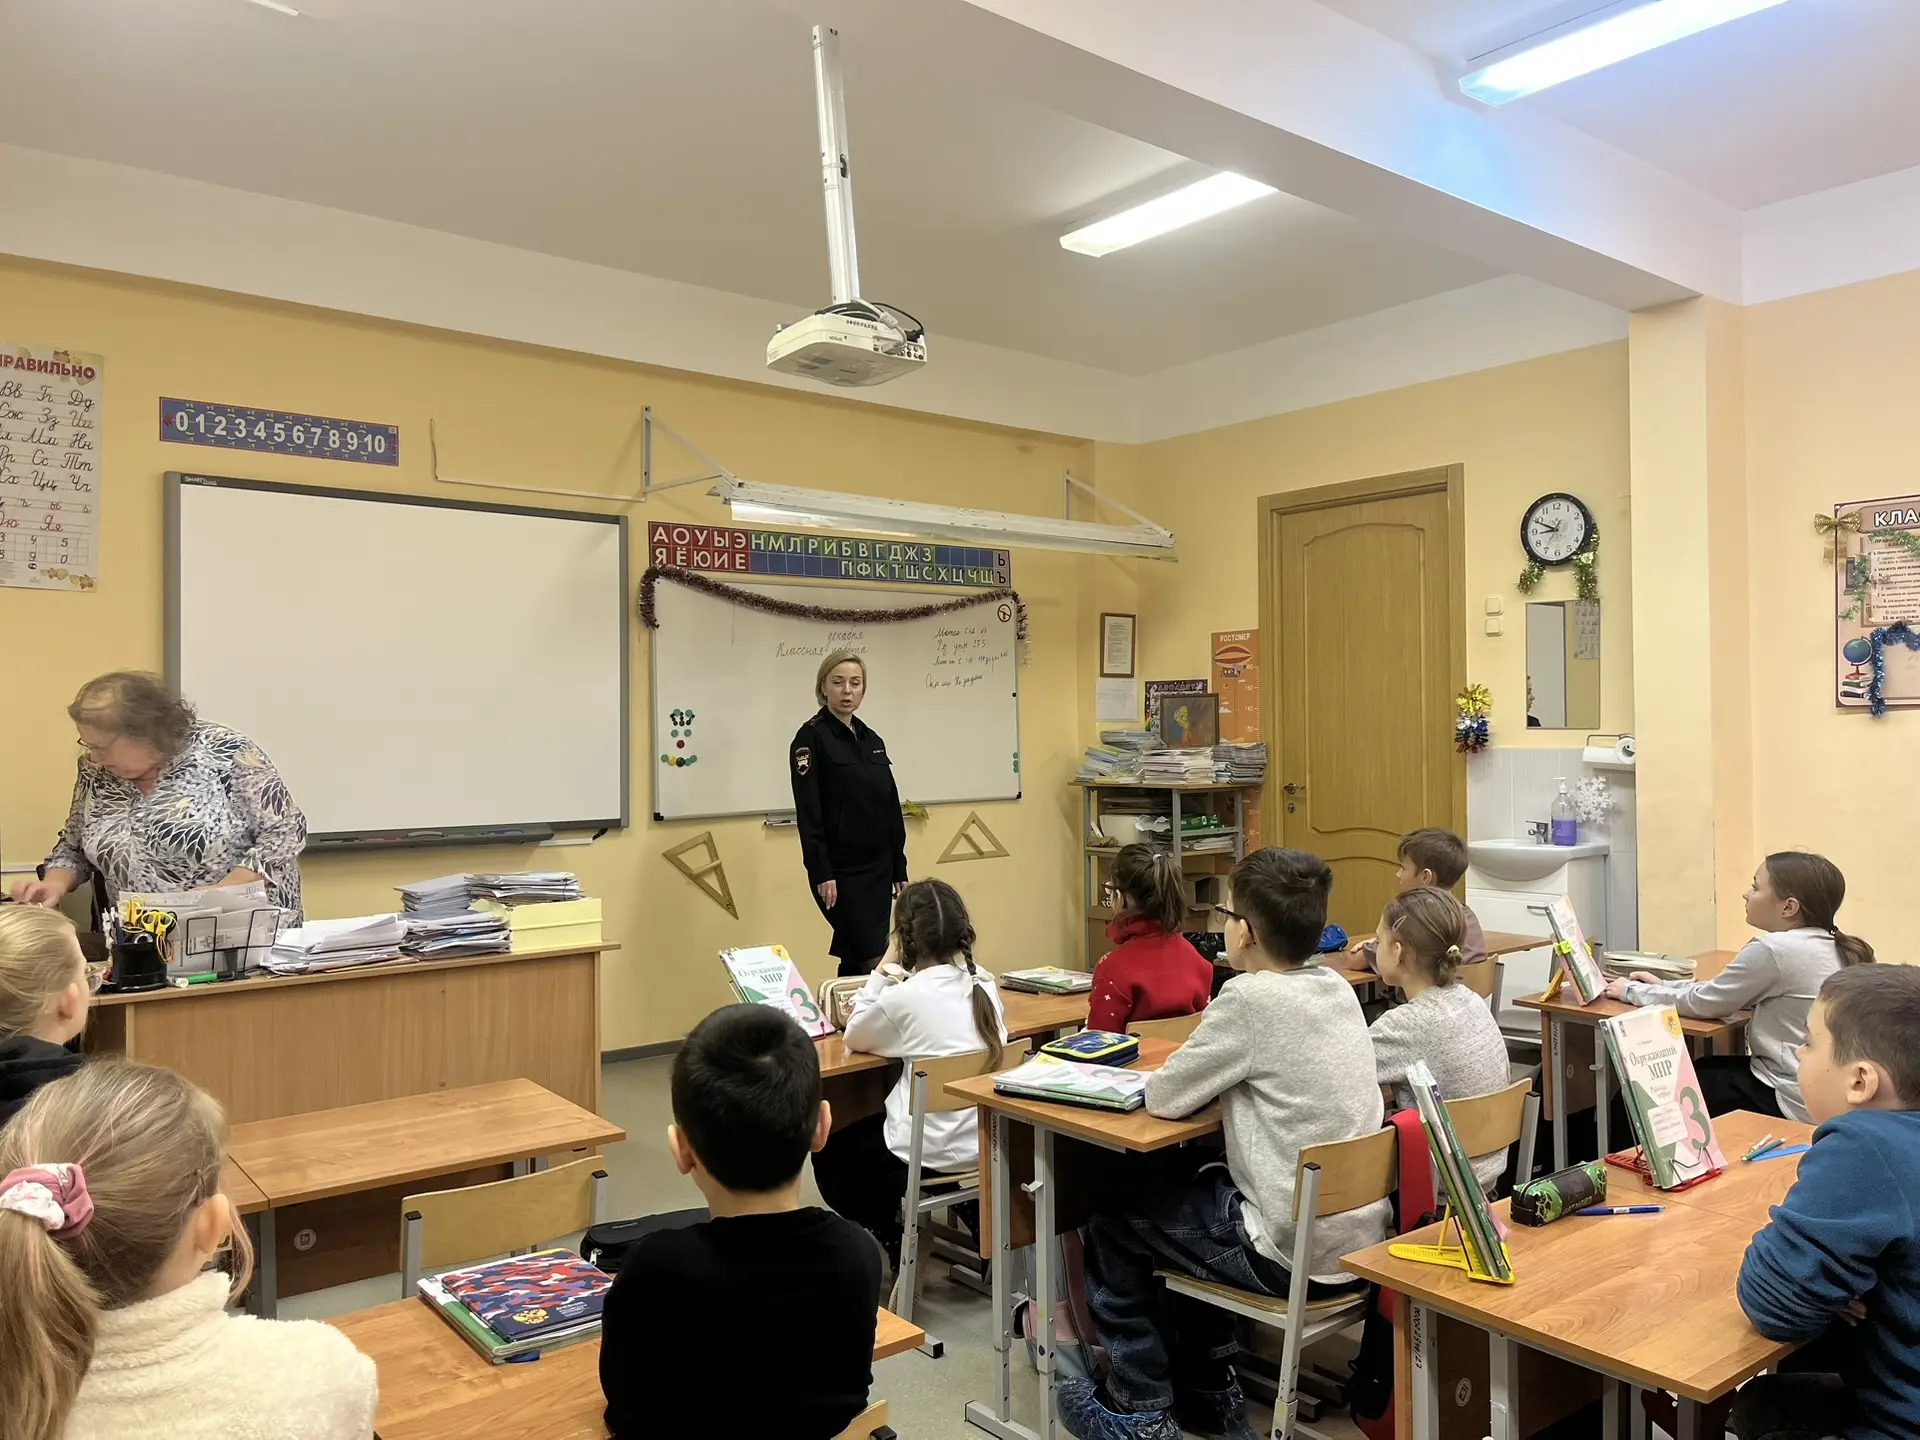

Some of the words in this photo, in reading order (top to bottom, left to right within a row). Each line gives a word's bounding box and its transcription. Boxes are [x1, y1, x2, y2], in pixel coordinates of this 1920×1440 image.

[0, 354, 95, 379] РАВИЛЬНО
[176, 411, 189, 431] 0
[196, 414, 205, 433] 1
[214, 416, 227, 436] 2
[235, 418, 247, 438] 3
[253, 421, 267, 440] 4
[274, 423, 285, 442] 5
[293, 425, 305, 444] 6
[311, 427, 322, 445] 7
[328, 430, 340, 448] 8
[347, 432, 358, 450] 9
[364, 434, 385, 453] 10
[1874, 507, 1920, 527] КЛА
[61, 538, 68, 547] 5
[653, 527, 669, 543] А
[672, 528, 690, 544] О
[694, 529, 708, 546] У
[714, 531, 729, 547] Ы
[734, 533, 746, 549] Э
[752, 534, 765, 550] Н
[768, 536, 785, 552] М
[788, 537, 801, 553] Л
[808, 539, 818, 554] Р
[824, 538, 837, 555] Й
[842, 542, 851, 556] Б
[859, 543, 868, 557] В
[876, 544, 884, 558] Г
[889, 545, 902, 561] Д
[905, 546, 918, 561] Ж
[922, 548, 932, 562] З
[999, 554, 1006, 567] Ь
[655, 549, 667, 564] Я
[676, 547, 687, 566] Ё
[693, 550, 711, 568] Ю
[714, 552, 729, 569] И
[735, 554, 746, 570] Е
[841, 561, 852, 575] П
[857, 562, 871, 576] Ф
[876, 564, 887, 578] К
[892, 565, 902, 578] Т
[905, 566, 919, 580] Ш
[922, 567, 933, 581] С
[938, 568, 949, 582] Х
[952, 569, 964, 584] Ц
[968, 570, 977, 584] Ч
[980, 571, 994, 585] Щ
[997, 571, 1007, 584] Ъ
[1220, 633, 1251, 642] РОСТОМЕР
[790, 988, 820, 1023] 3
[1647, 1060, 1672, 1080] МИР
[1680, 1086, 1710, 1150] 3
